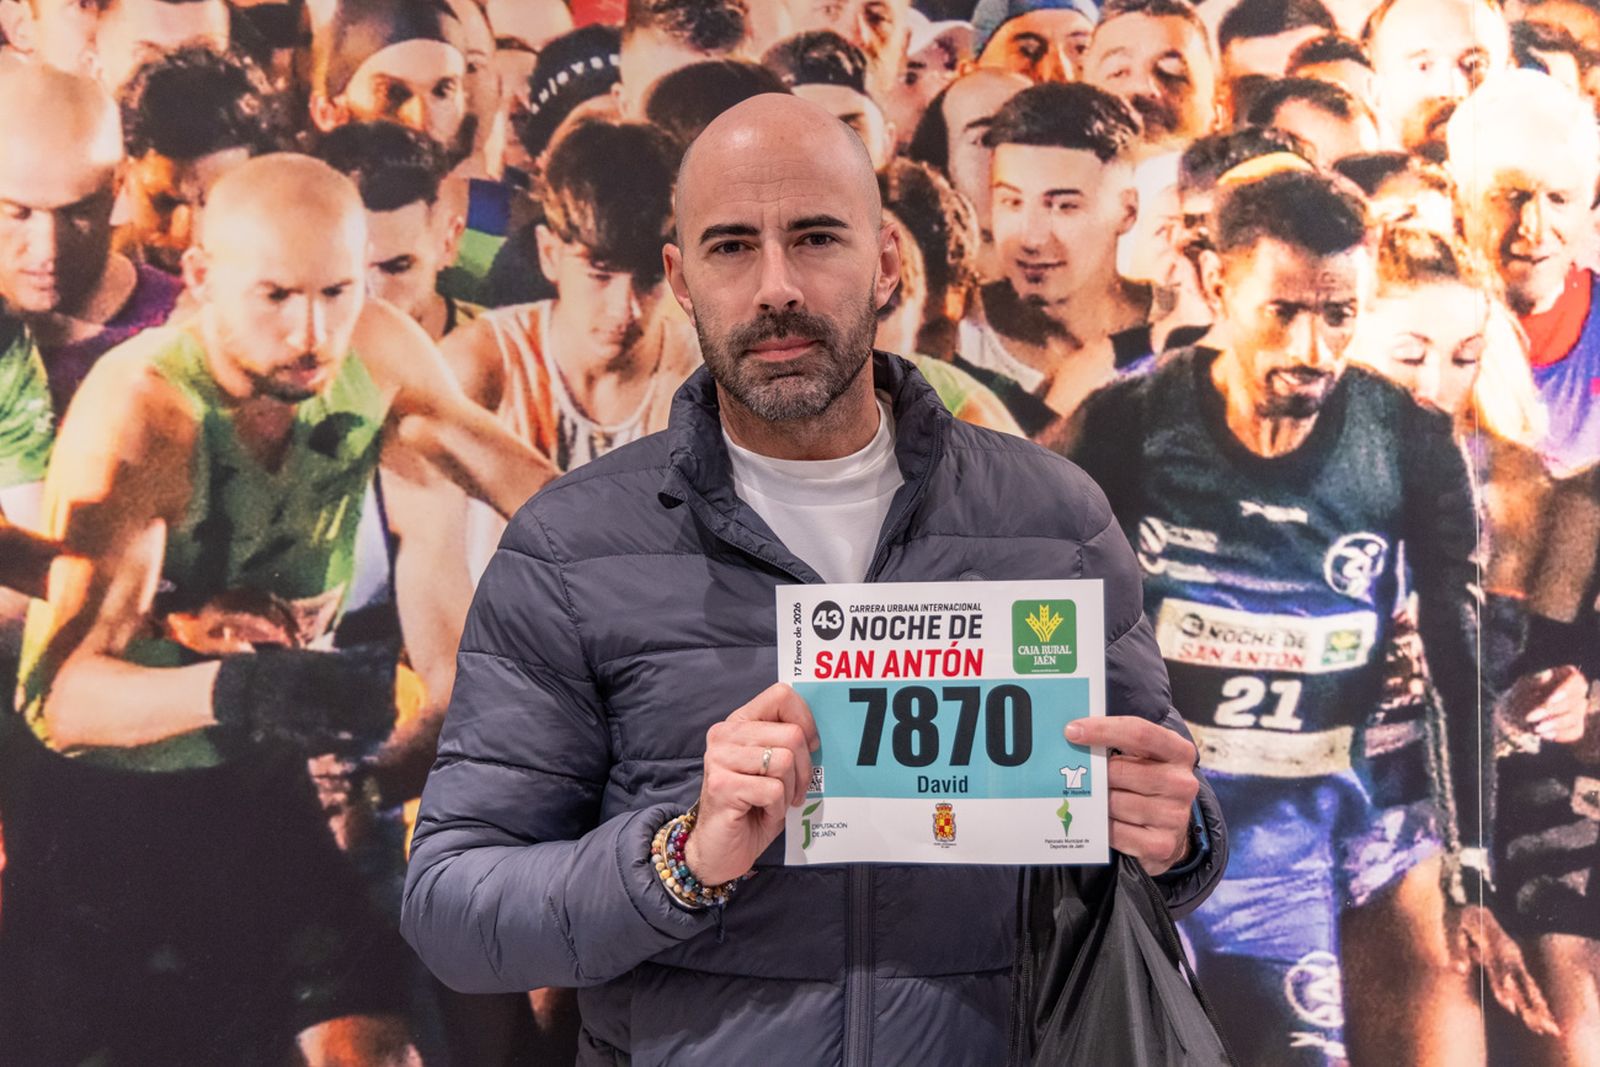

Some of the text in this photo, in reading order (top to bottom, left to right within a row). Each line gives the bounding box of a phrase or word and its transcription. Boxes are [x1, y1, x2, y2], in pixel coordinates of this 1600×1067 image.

[849, 602, 982, 614] CARRERA URBANA INTERNACIONAL
[813, 609, 844, 630] 43
[850, 614, 983, 641] NOCHE DE
[793, 602, 802, 677] 17 Enero de 2026
[1018, 644, 1072, 655] CAJA RURAL
[814, 641, 984, 680] SAN ANTÓN
[1033, 654, 1056, 666] JAÉN
[1212, 676, 1303, 731] 21
[849, 684, 1033, 768] 7870
[917, 775, 968, 793] David
[812, 822, 848, 830] DIPUTACIÓN
[821, 830, 836, 838] JAÉN
